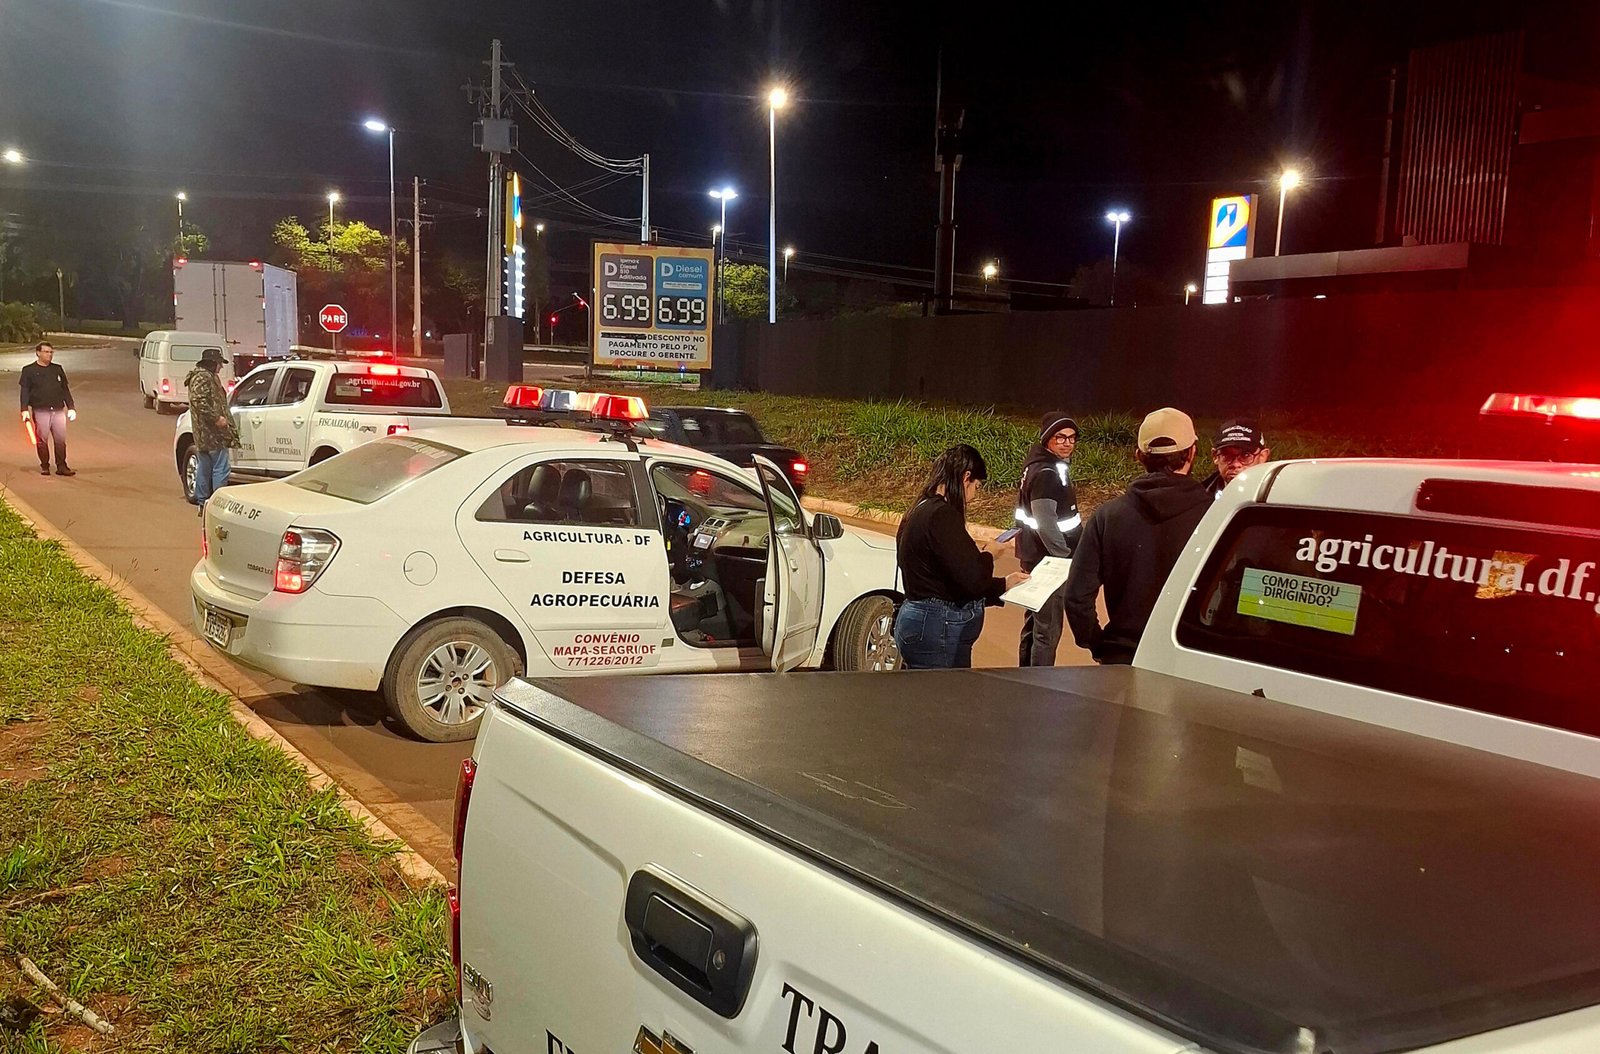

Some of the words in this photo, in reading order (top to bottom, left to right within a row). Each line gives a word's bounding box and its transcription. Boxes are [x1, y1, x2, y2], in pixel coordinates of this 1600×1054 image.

[604, 261, 617, 276] D
[661, 262, 674, 276] D
[676, 264, 702, 273] Diesel
[603, 294, 650, 320] 6.99
[658, 297, 704, 324] 6.99
[322, 314, 346, 324] PARE
[608, 341, 658, 349] PAGAMENTO
[647, 334, 691, 342] DESCONTO
[658, 352, 696, 360] GERENTE.
[318, 417, 360, 430] FISCALIZAÇÃO
[248, 508, 262, 520] DF
[523, 531, 624, 544] AGRICULTURA
[634, 535, 650, 546] DF
[562, 571, 626, 585] DEFESA
[1296, 533, 1600, 615] agricultura.df.
[1262, 574, 1298, 590] COMO
[1302, 580, 1340, 596] ESTOU
[530, 592, 660, 608] AGROPECUÁRIA
[1264, 586, 1333, 608] DIRIGINDO?
[574, 632, 640, 644] CONVÊNIO
[568, 656, 644, 666] 771226/2012
[781, 982, 880, 1054] TR
